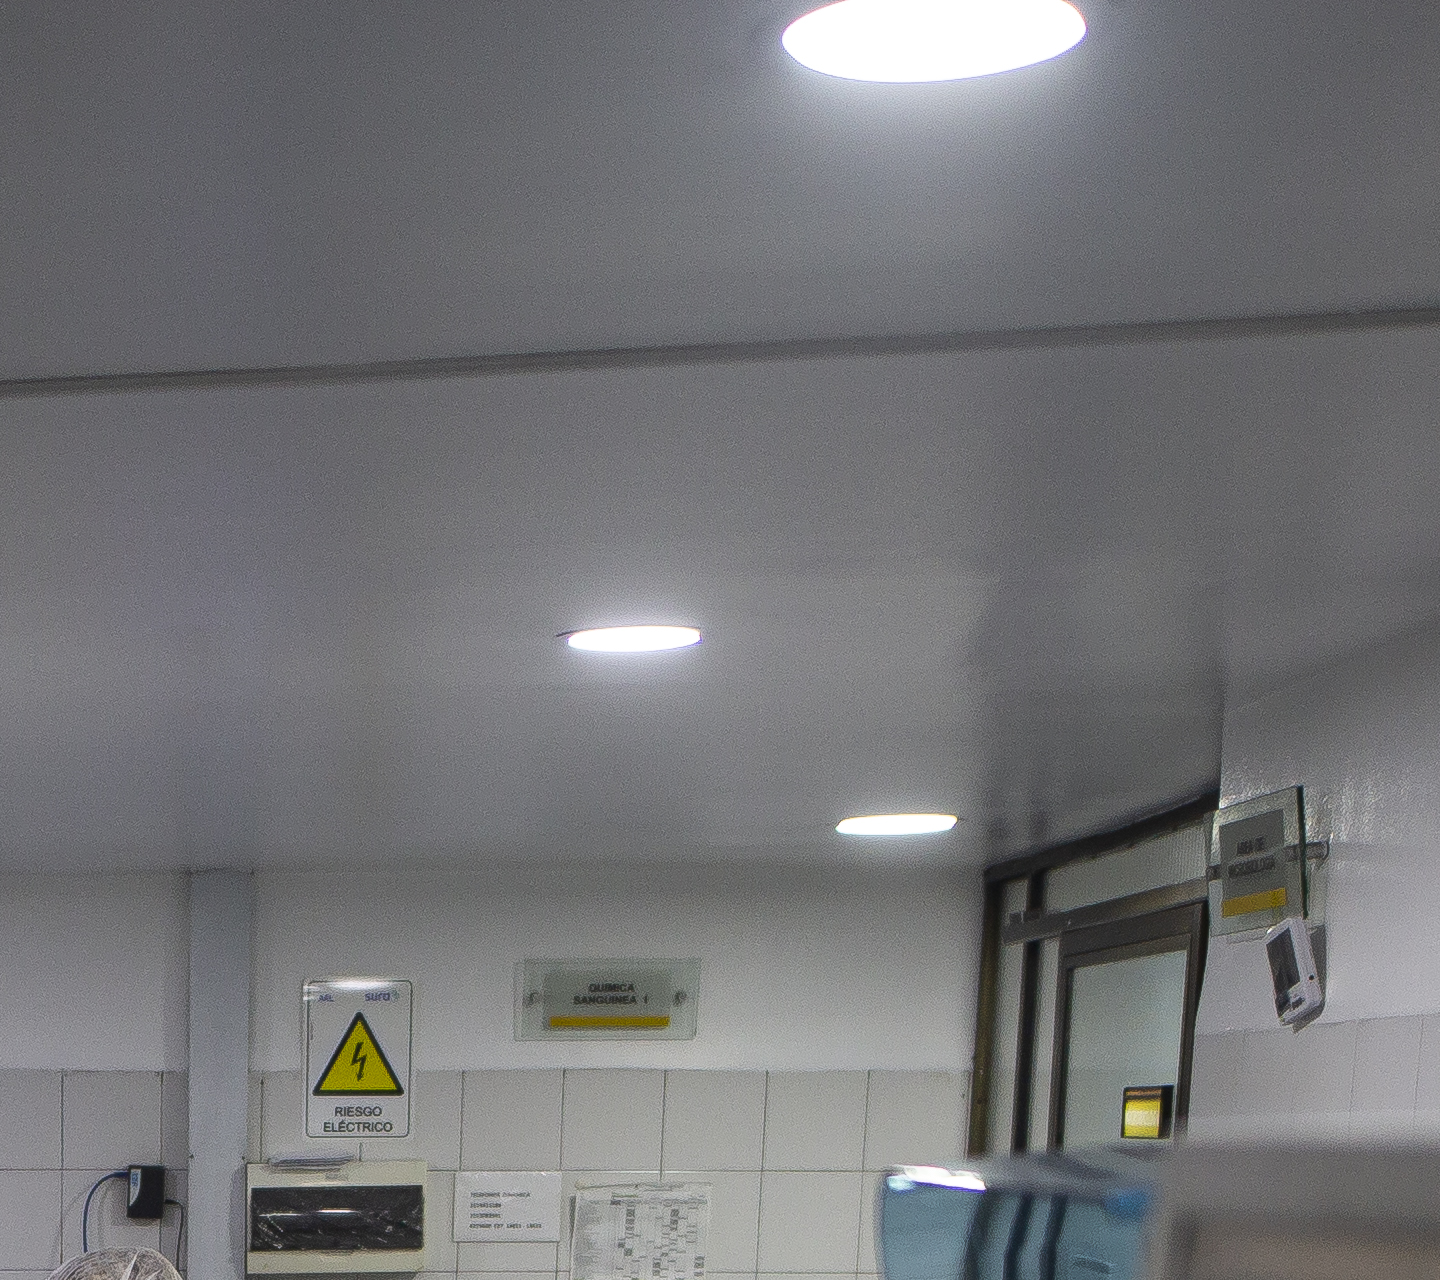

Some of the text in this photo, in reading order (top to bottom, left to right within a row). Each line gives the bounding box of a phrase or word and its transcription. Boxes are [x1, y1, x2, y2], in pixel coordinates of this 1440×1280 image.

[573, 995, 637, 1005] SANGUINEA
[334, 1106, 383, 1117] RIESGO
[323, 1120, 393, 1132] ELÉCTRICO
